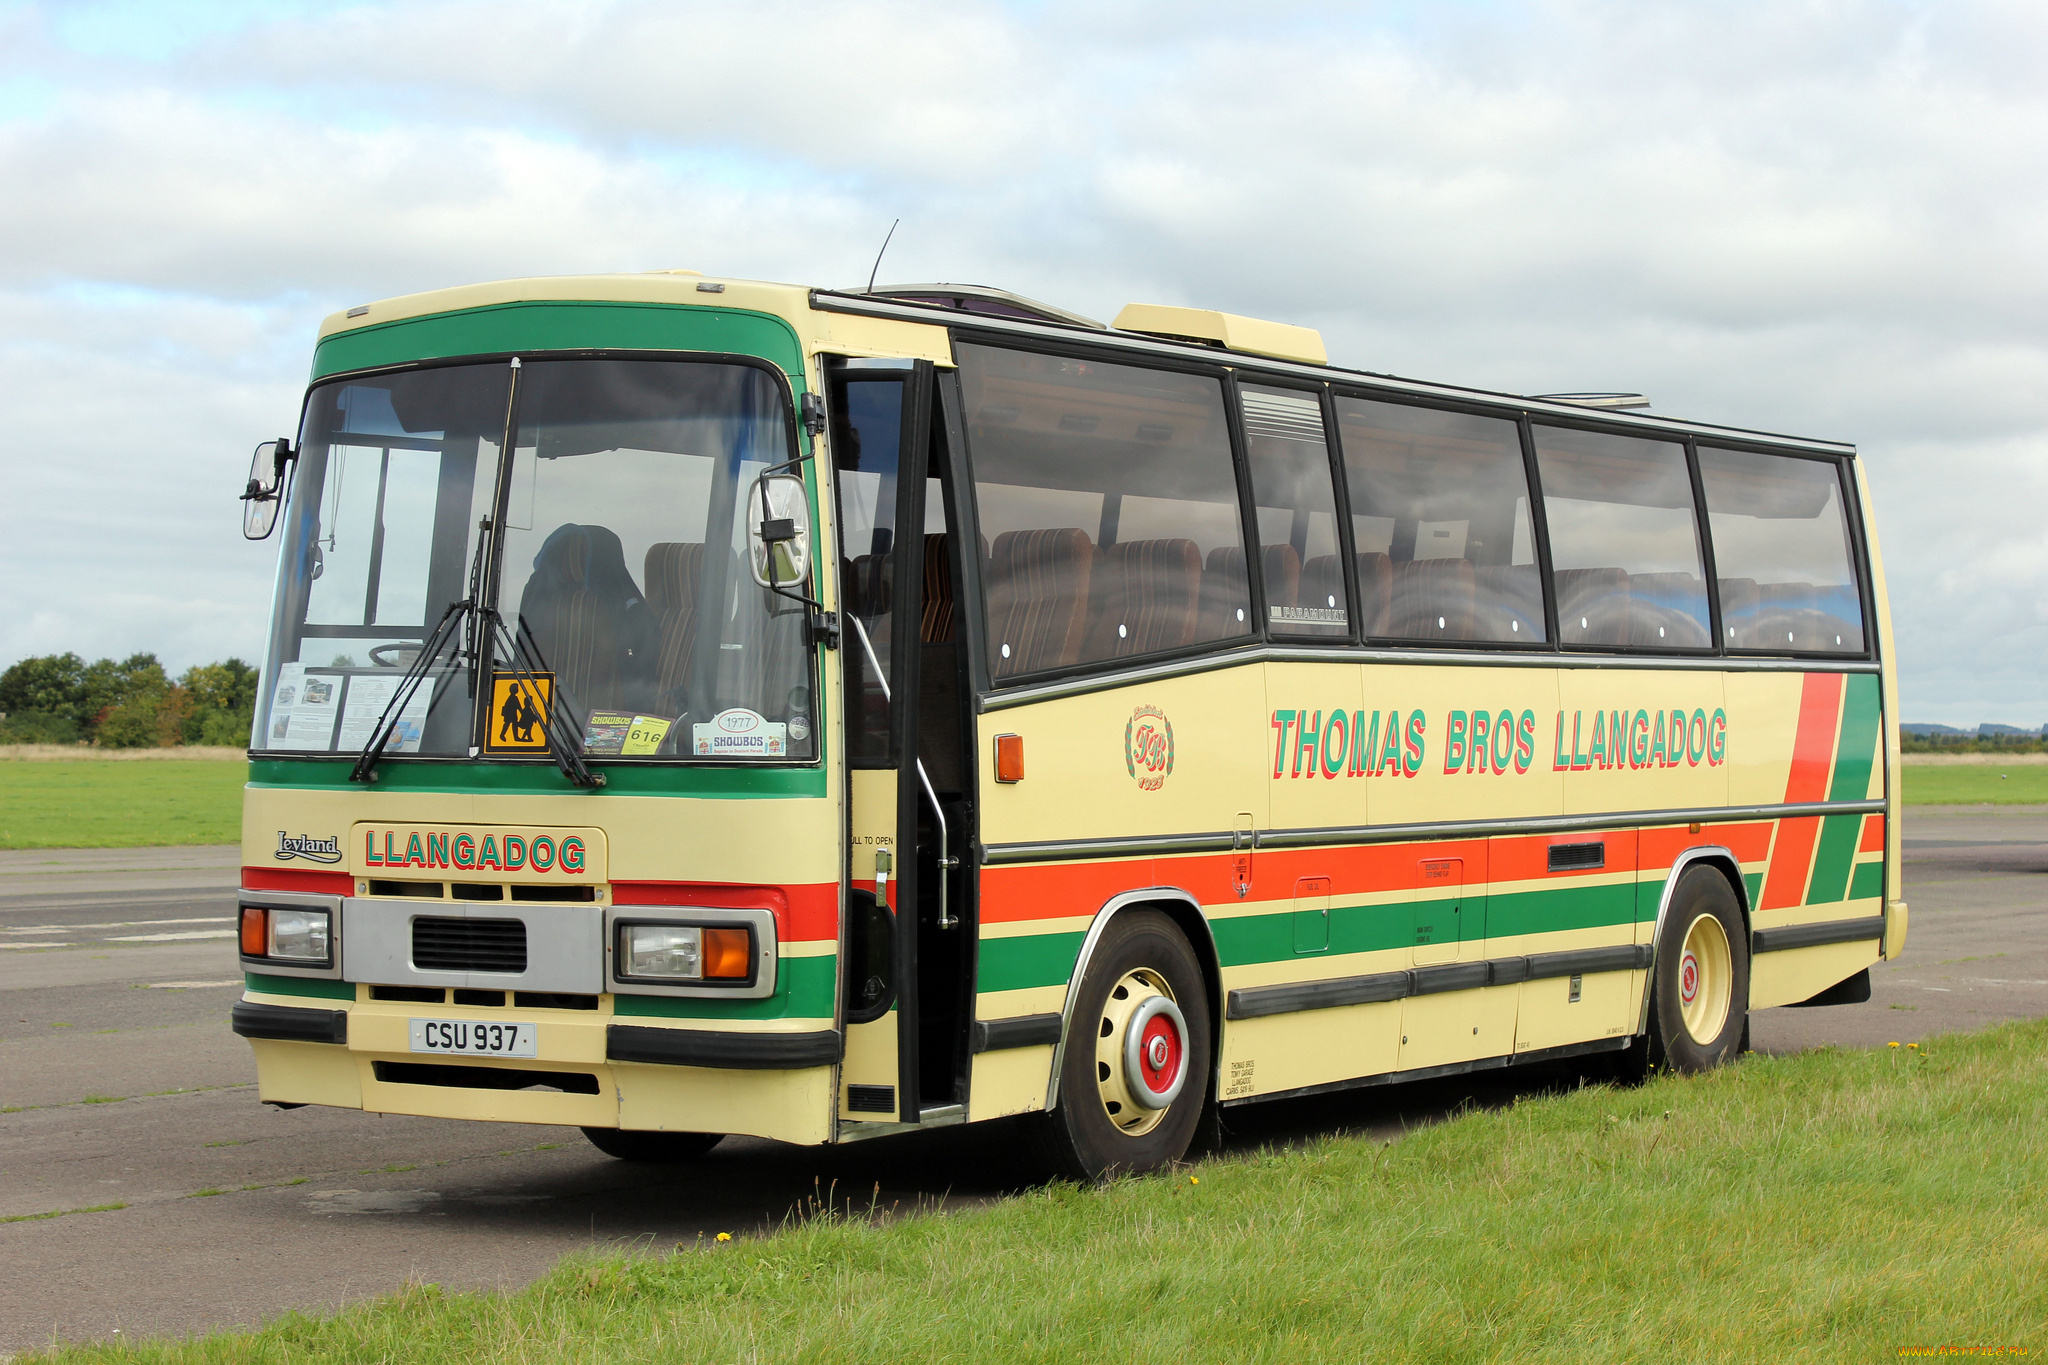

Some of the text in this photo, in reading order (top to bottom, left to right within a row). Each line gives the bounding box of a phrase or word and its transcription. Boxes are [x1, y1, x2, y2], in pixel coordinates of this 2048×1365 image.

[1283, 606, 1344, 620] PARAMOUNT
[591, 716, 632, 725] SHOWBUS
[727, 717, 751, 728] 1977
[631, 729, 661, 743] 616
[714, 736, 763, 747] SHOWBUS
[1270, 707, 1727, 779] THOMAS BROS LLANGADOG
[1138, 774, 1164, 791] 1923
[274, 831, 342, 863] Leyland
[864, 836, 873, 844] TO
[875, 836, 893, 845] OPEN
[366, 830, 585, 874] LLANGADOG
[425, 1022, 518, 1051] CSU 937
